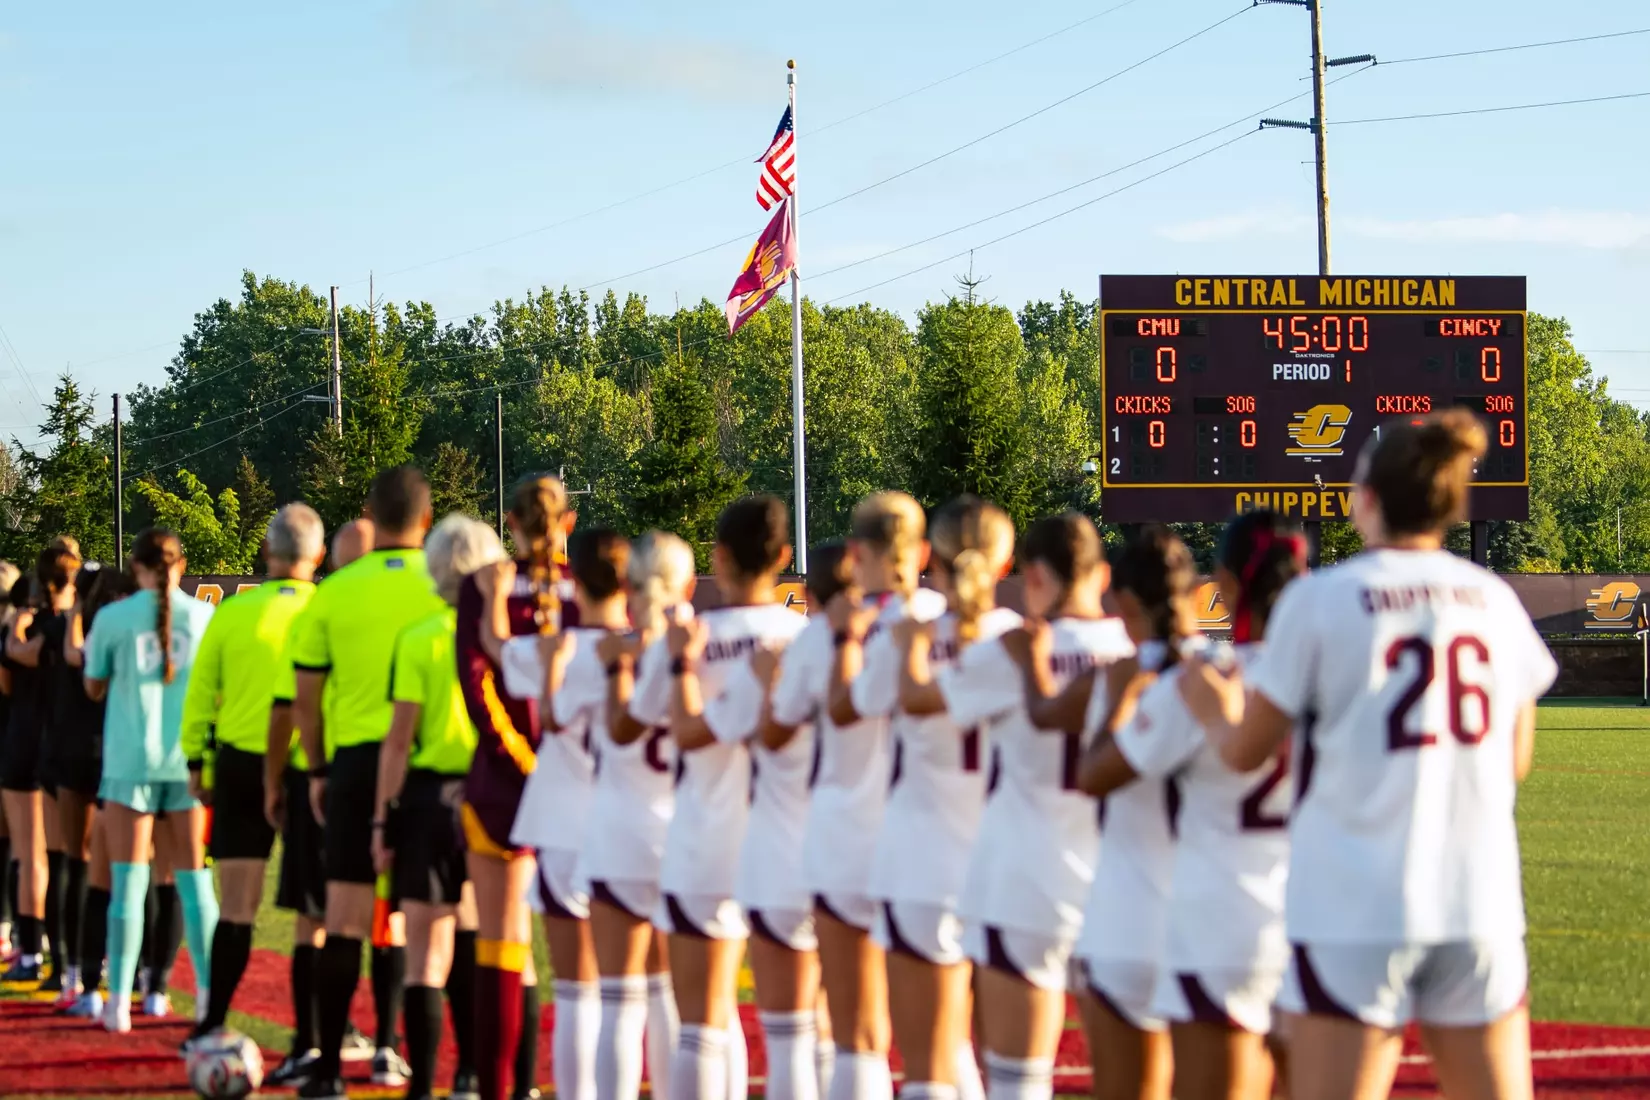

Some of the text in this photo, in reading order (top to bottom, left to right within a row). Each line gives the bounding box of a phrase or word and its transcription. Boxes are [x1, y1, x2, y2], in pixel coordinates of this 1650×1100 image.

[1175, 278, 1456, 306] CENTRAL MICHIGAN
[1137, 318, 1180, 336] CMU
[1263, 316, 1369, 351] 45:00
[1439, 318, 1501, 336] CINCY
[1156, 346, 1176, 383] 0
[1272, 359, 1351, 383] PERIOD 1
[1481, 347, 1501, 382] 0
[1115, 396, 1171, 414] CKICKS
[1226, 396, 1256, 413] SOG
[1376, 395, 1431, 413] CKICKS
[1485, 395, 1514, 413] SOG
[1111, 426, 1120, 443] 1
[1149, 420, 1165, 447] 0
[1240, 420, 1257, 447] 0
[1372, 425, 1381, 442] 1
[1499, 420, 1515, 447] 0
[1110, 457, 1121, 475] 2
[1384, 635, 1490, 752] 26
